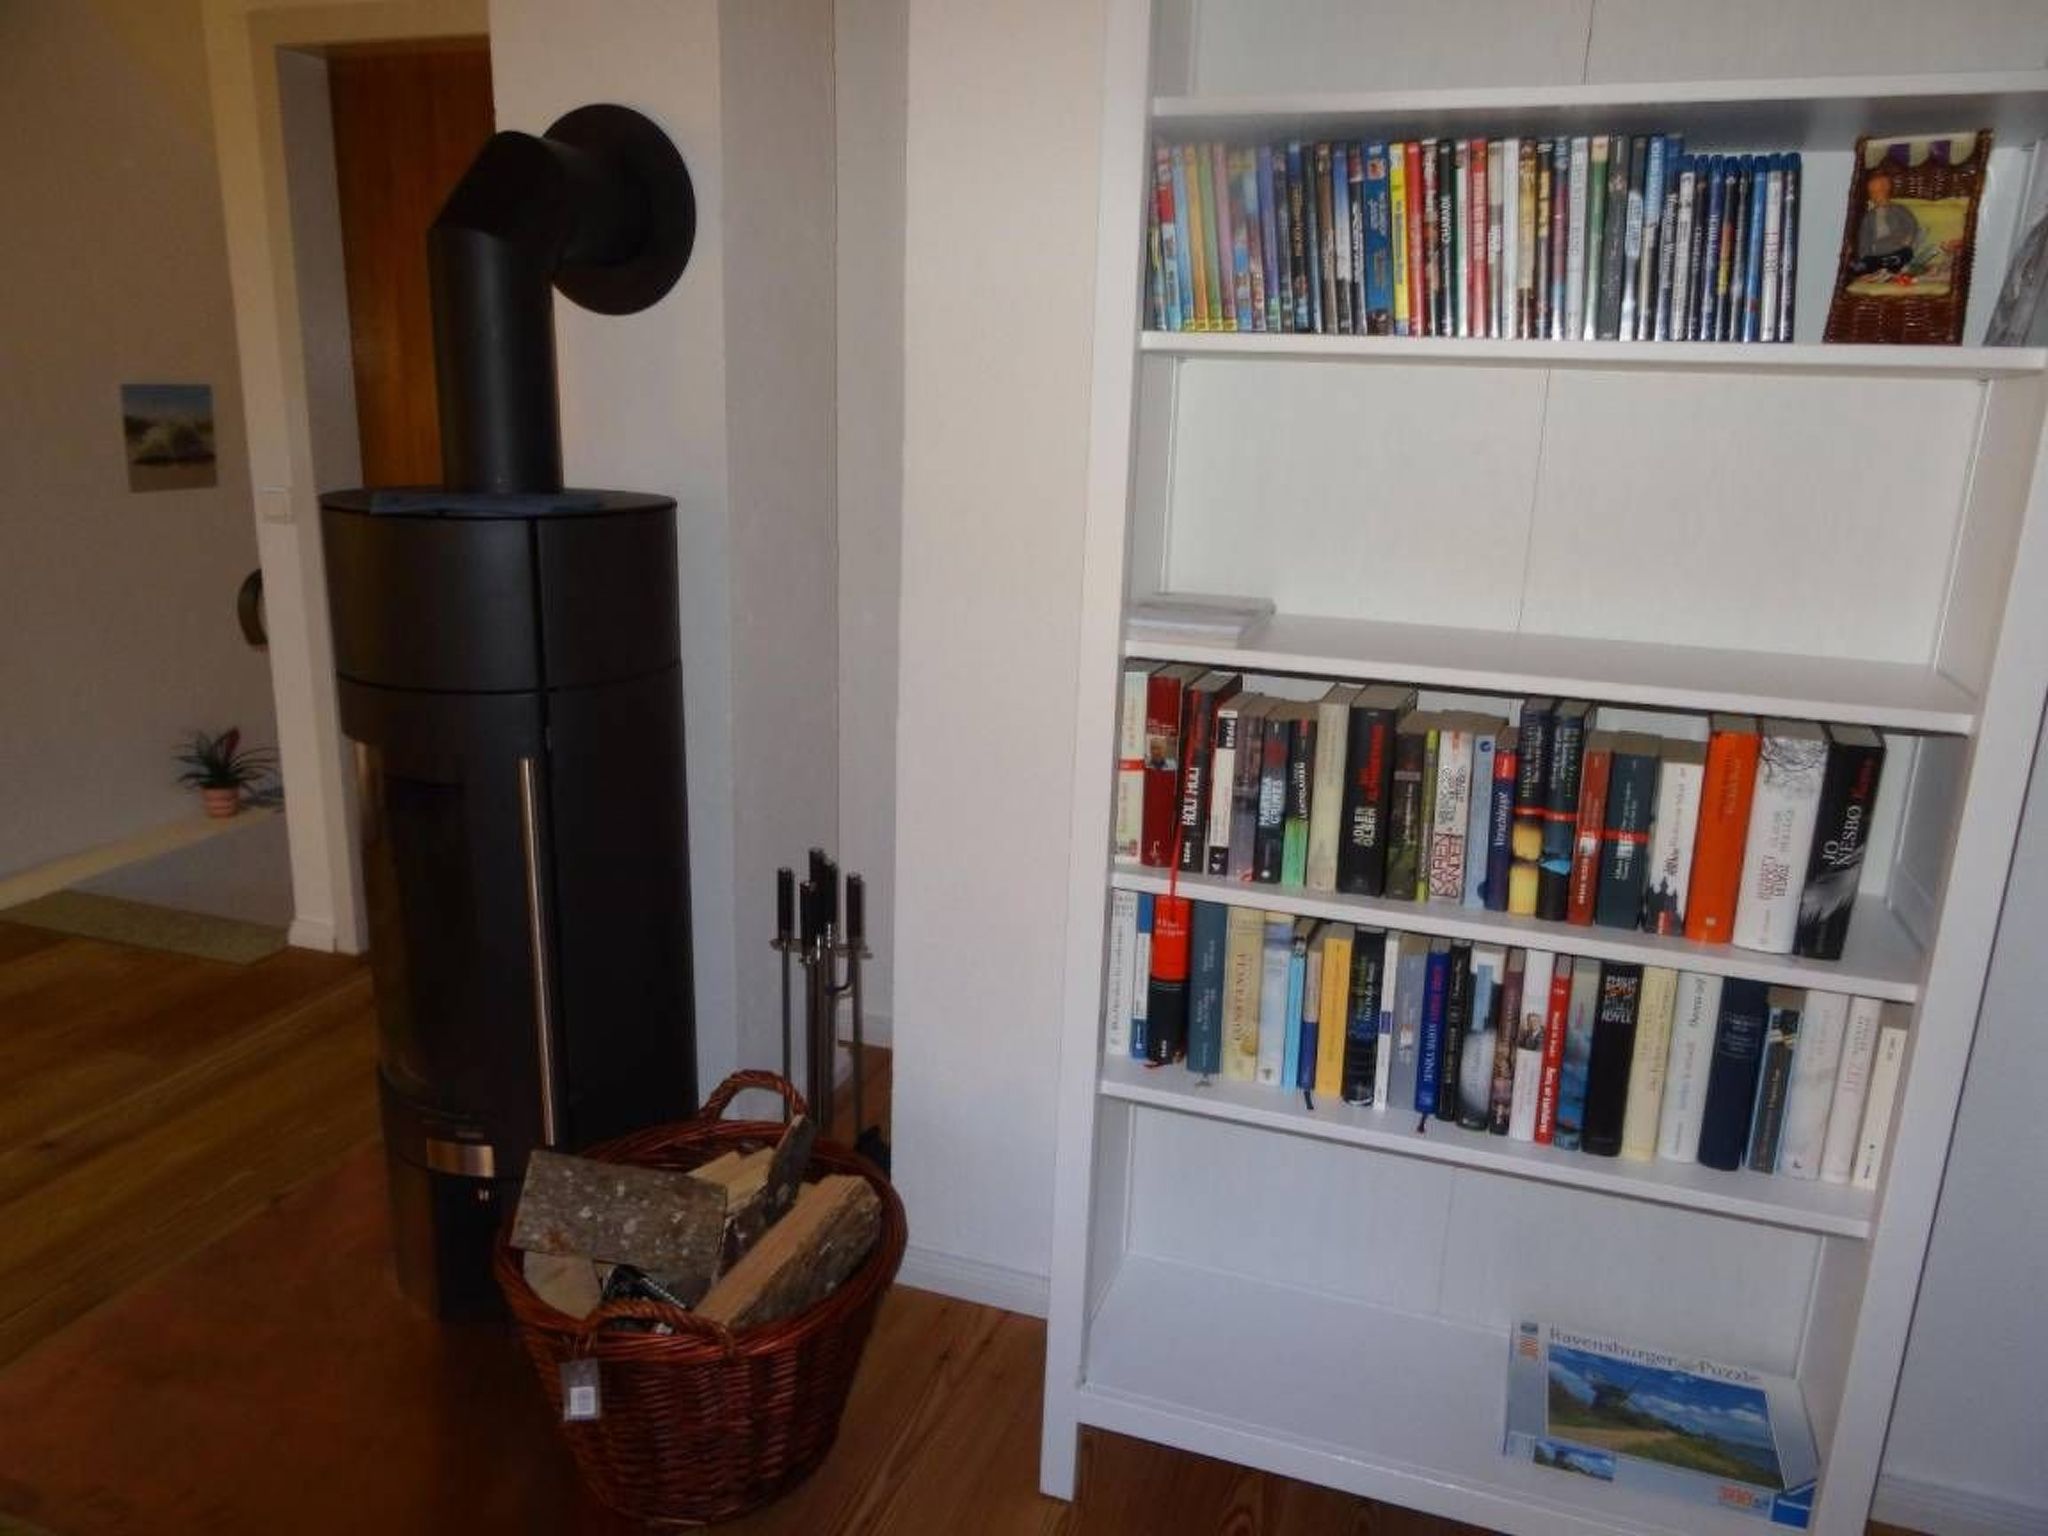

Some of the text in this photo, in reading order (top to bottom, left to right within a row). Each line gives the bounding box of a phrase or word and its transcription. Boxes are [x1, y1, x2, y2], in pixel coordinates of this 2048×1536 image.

[1363, 806, 1377, 847] OLSEN
[1821, 840, 1840, 866] JO
[1430, 833, 1449, 896] KAREN
[1445, 833, 1465, 898] SANDER
[1550, 1325, 1763, 1384] Ravensburger Puzzle
